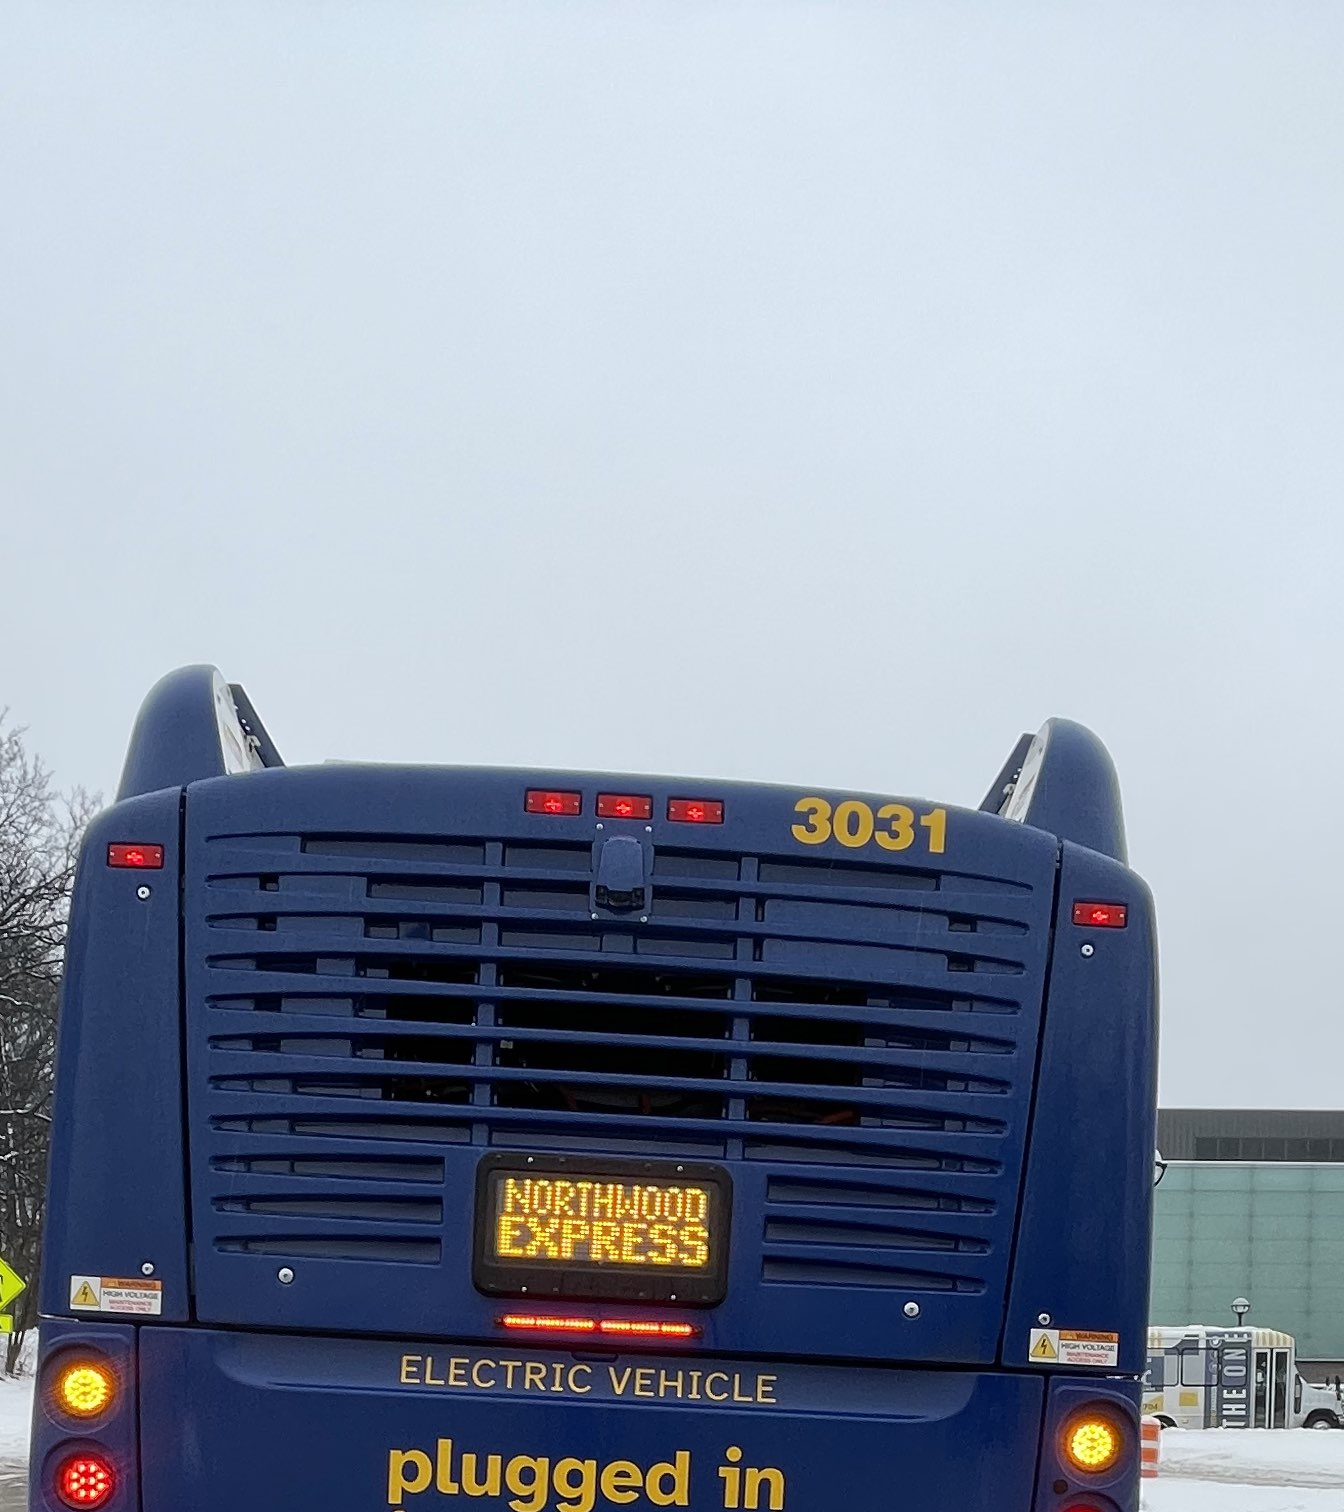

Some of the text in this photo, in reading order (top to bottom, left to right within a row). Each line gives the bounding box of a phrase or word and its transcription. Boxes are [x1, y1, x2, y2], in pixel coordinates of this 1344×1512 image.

[791, 796, 947, 854] 3031
[505, 1178, 708, 1222] NORTHWOOD
[497, 1215, 709, 1267] EXPRESS
[102, 1290, 159, 1300] HIGH VOLTAGE
[1061, 1342, 1115, 1352] HIGH VOLTAGE
[400, 1354, 778, 1404] ELECTRIC VEHICLE
[718, 1446, 785, 1511] in
